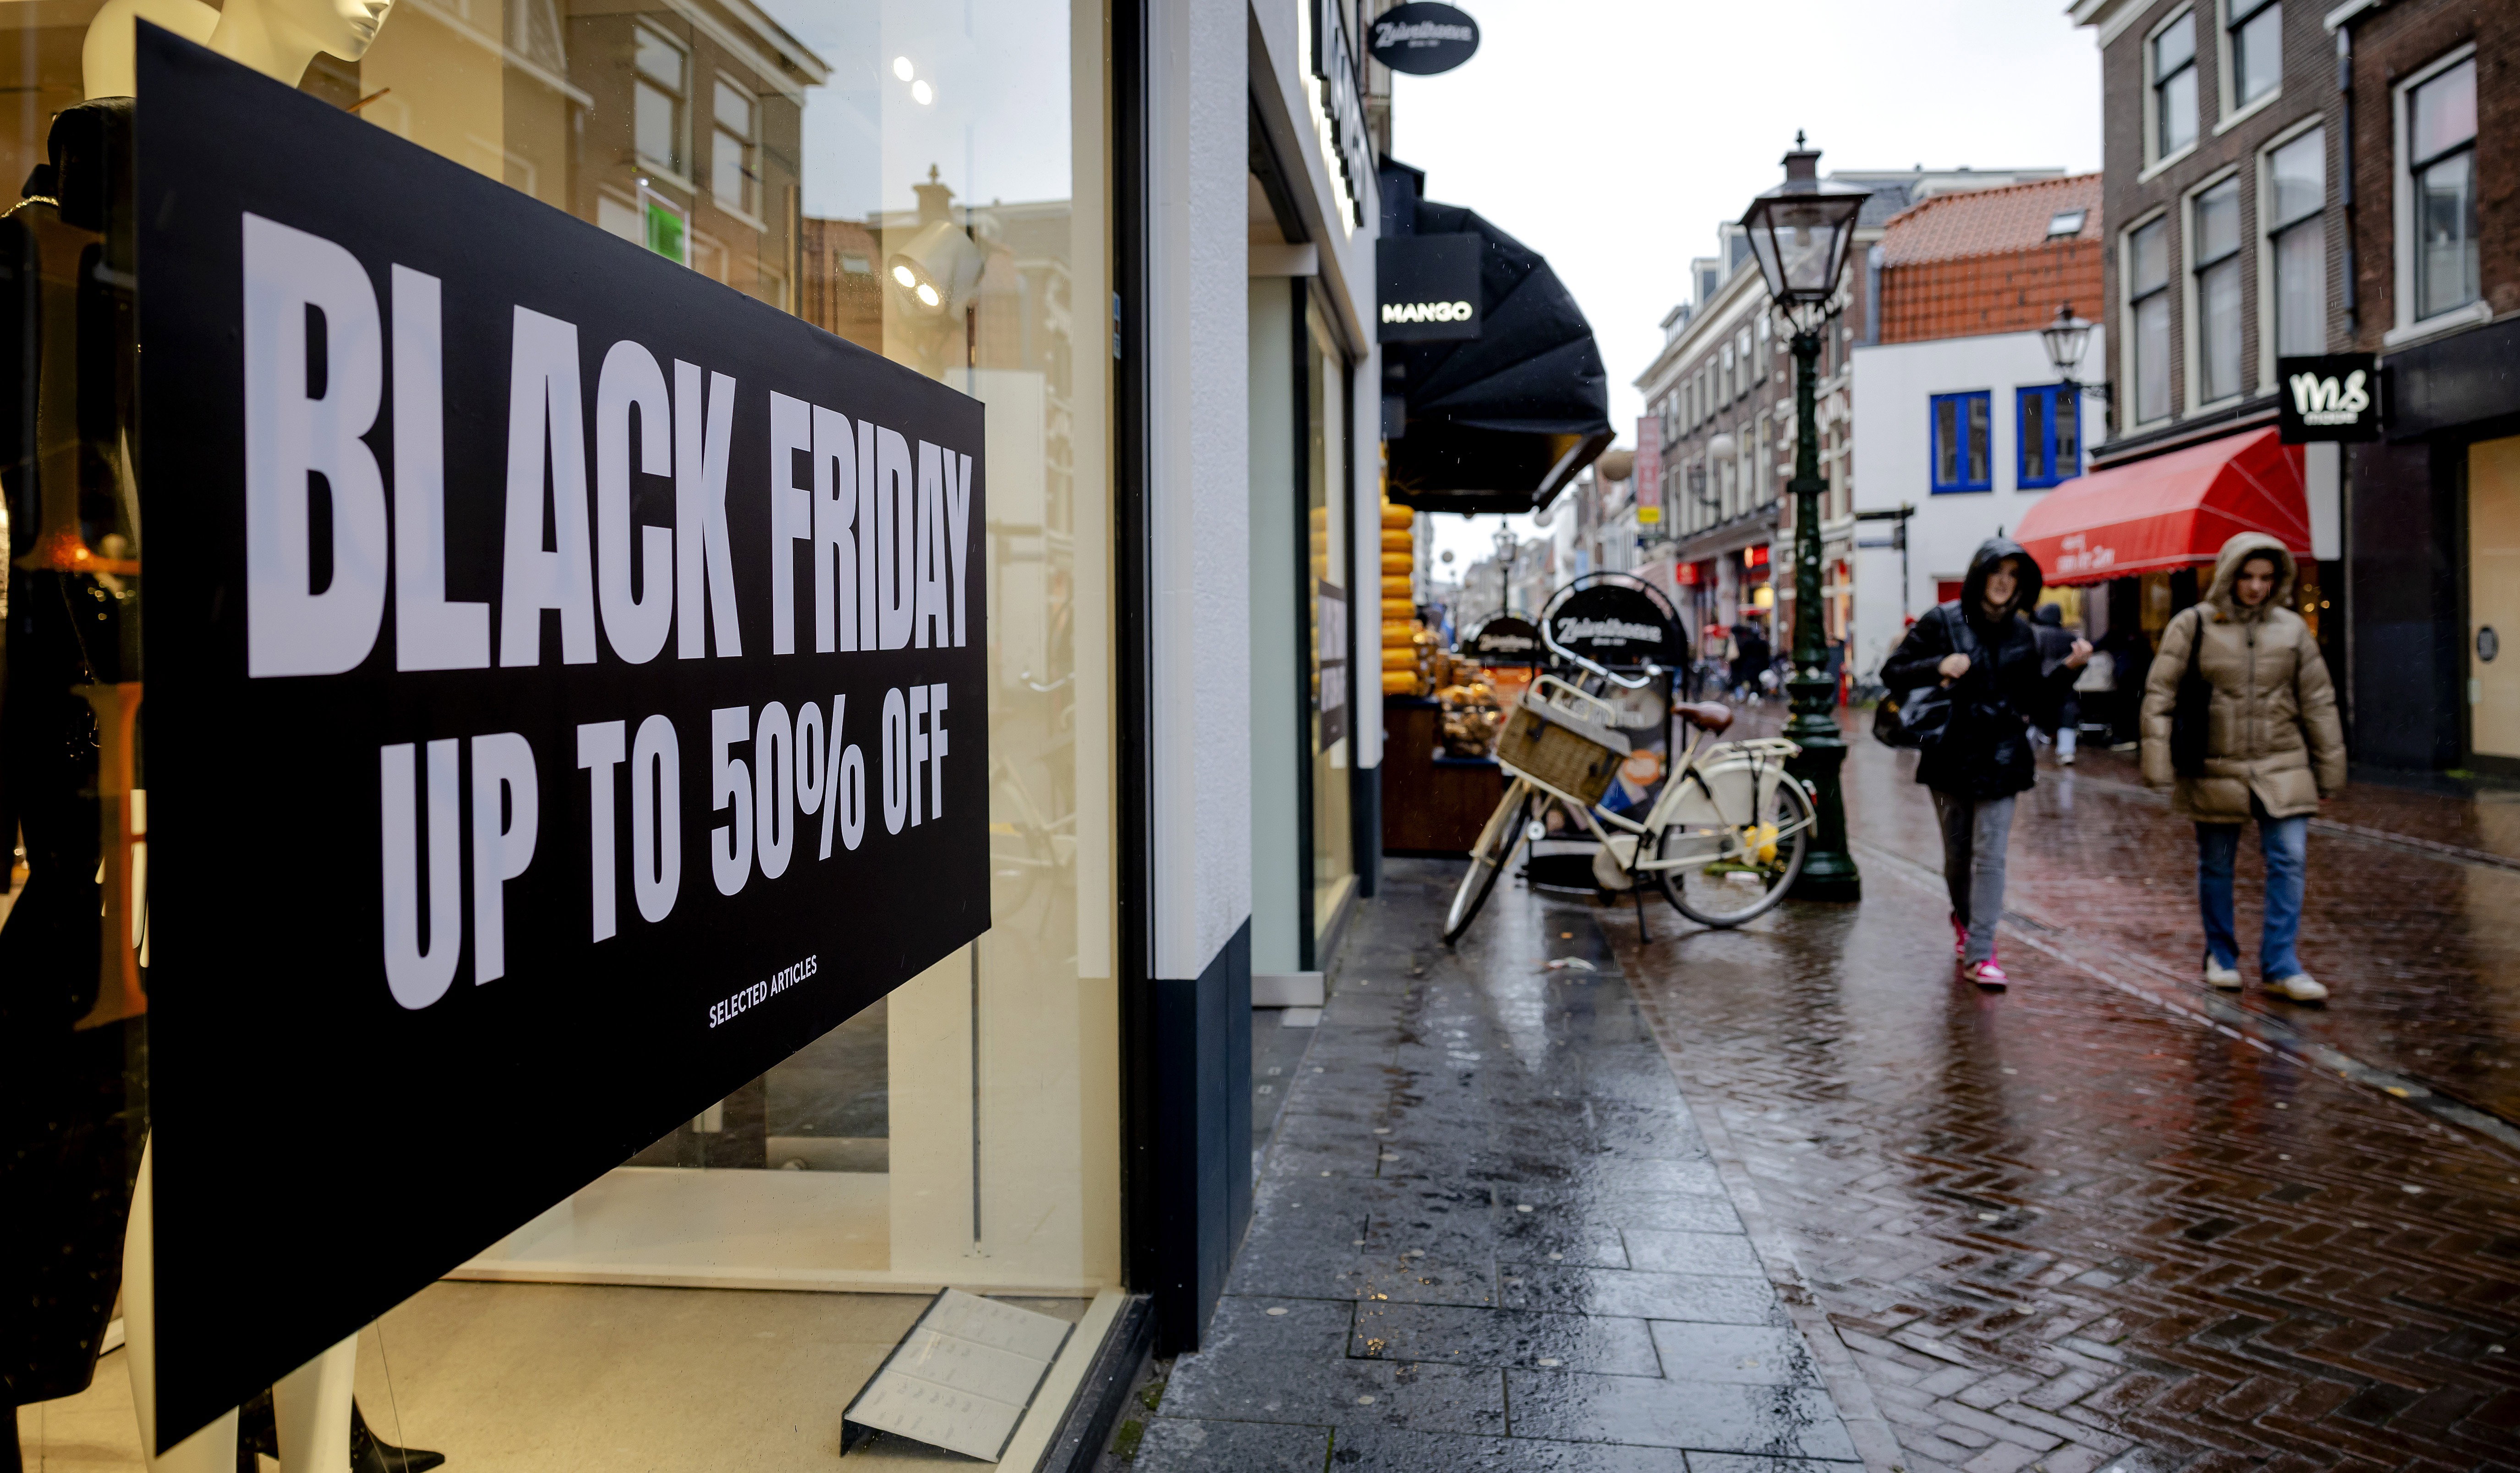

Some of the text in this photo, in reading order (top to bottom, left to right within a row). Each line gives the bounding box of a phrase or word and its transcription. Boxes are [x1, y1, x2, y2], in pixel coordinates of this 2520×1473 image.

[1382, 301, 1473, 323] MANGO
[243, 212, 972, 677] BLACK FRIDAY
[381, 683, 949, 1011] UP TO 50% OFF
[709, 954, 817, 1028] SELECTED ARTICLES
